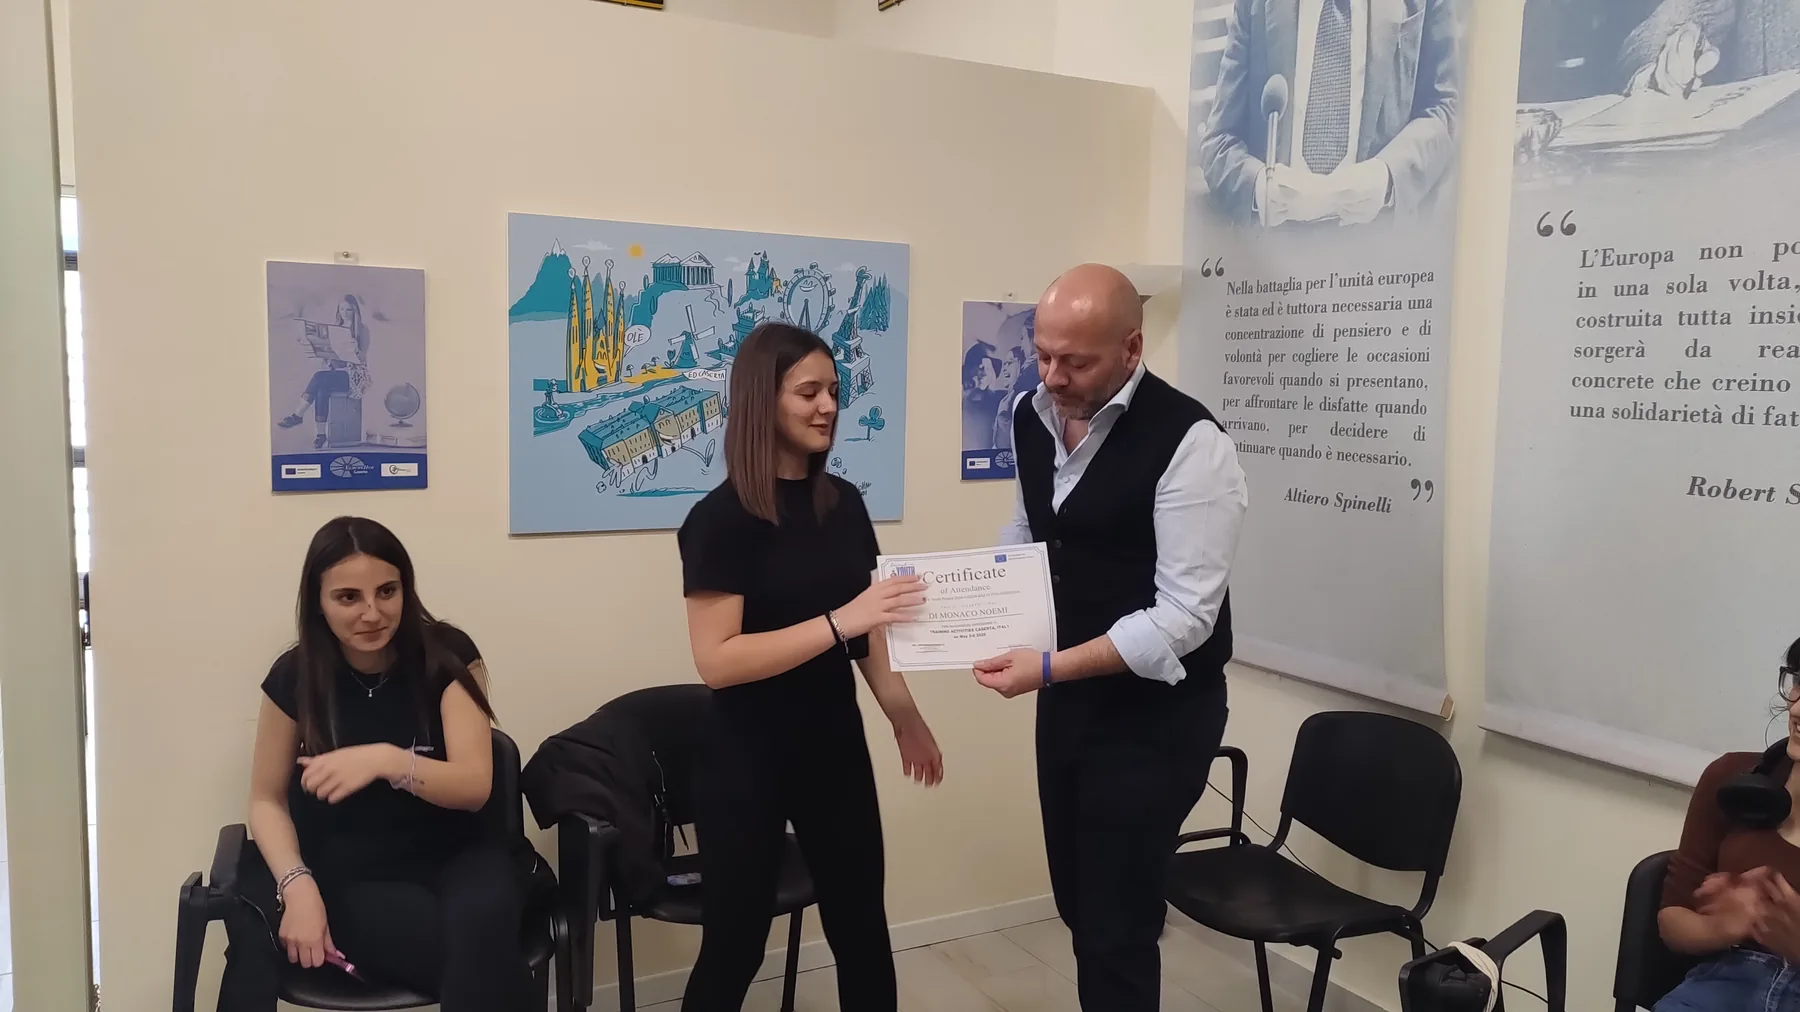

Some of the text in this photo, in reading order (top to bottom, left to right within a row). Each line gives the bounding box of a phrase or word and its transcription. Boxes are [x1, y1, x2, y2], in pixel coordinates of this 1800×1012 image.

[1699, 243, 1743, 261] non
[1227, 280, 1253, 296] Nella
[1256, 276, 1302, 296] battaglia
[1305, 277, 1326, 294] per
[1378, 271, 1434, 290] europea
[1577, 270, 1800, 299] in una sola volta,
[1225, 297, 1433, 318] è stata ed è tuttora necessaria una
[1575, 309, 1663, 329] costruita
[1677, 310, 1733, 327] tutta
[1225, 320, 1432, 342] concentrazione di pensiero e di
[1224, 347, 1431, 367] volontà per cogliere le occasioni
[1573, 340, 1646, 363] sorgerà
[1684, 338, 1712, 359] da
[1222, 371, 1429, 391] favorevoli quando si presentano,
[1571, 370, 1791, 394] concrete che creino
[1222, 394, 1427, 418] per affrontare le disfatte quando
[1570, 401, 1800, 428] una solidarietà di fat
[1288, 421, 1308, 437] per
[1330, 421, 1388, 439] decidere
[1413, 426, 1426, 442] di
[1278, 443, 1322, 460] quando
[1326, 445, 1333, 460] è
[1336, 450, 1412, 467] necessario.
[1284, 487, 1392, 513] Altiero Spinelli
[1686, 475, 1776, 503] Robert
[923, 566, 1006, 584] Certificate
[950, 584, 991, 594] Attendance
[940, 610, 978, 619] MONACO
[979, 607, 1008, 616] NOEMI
